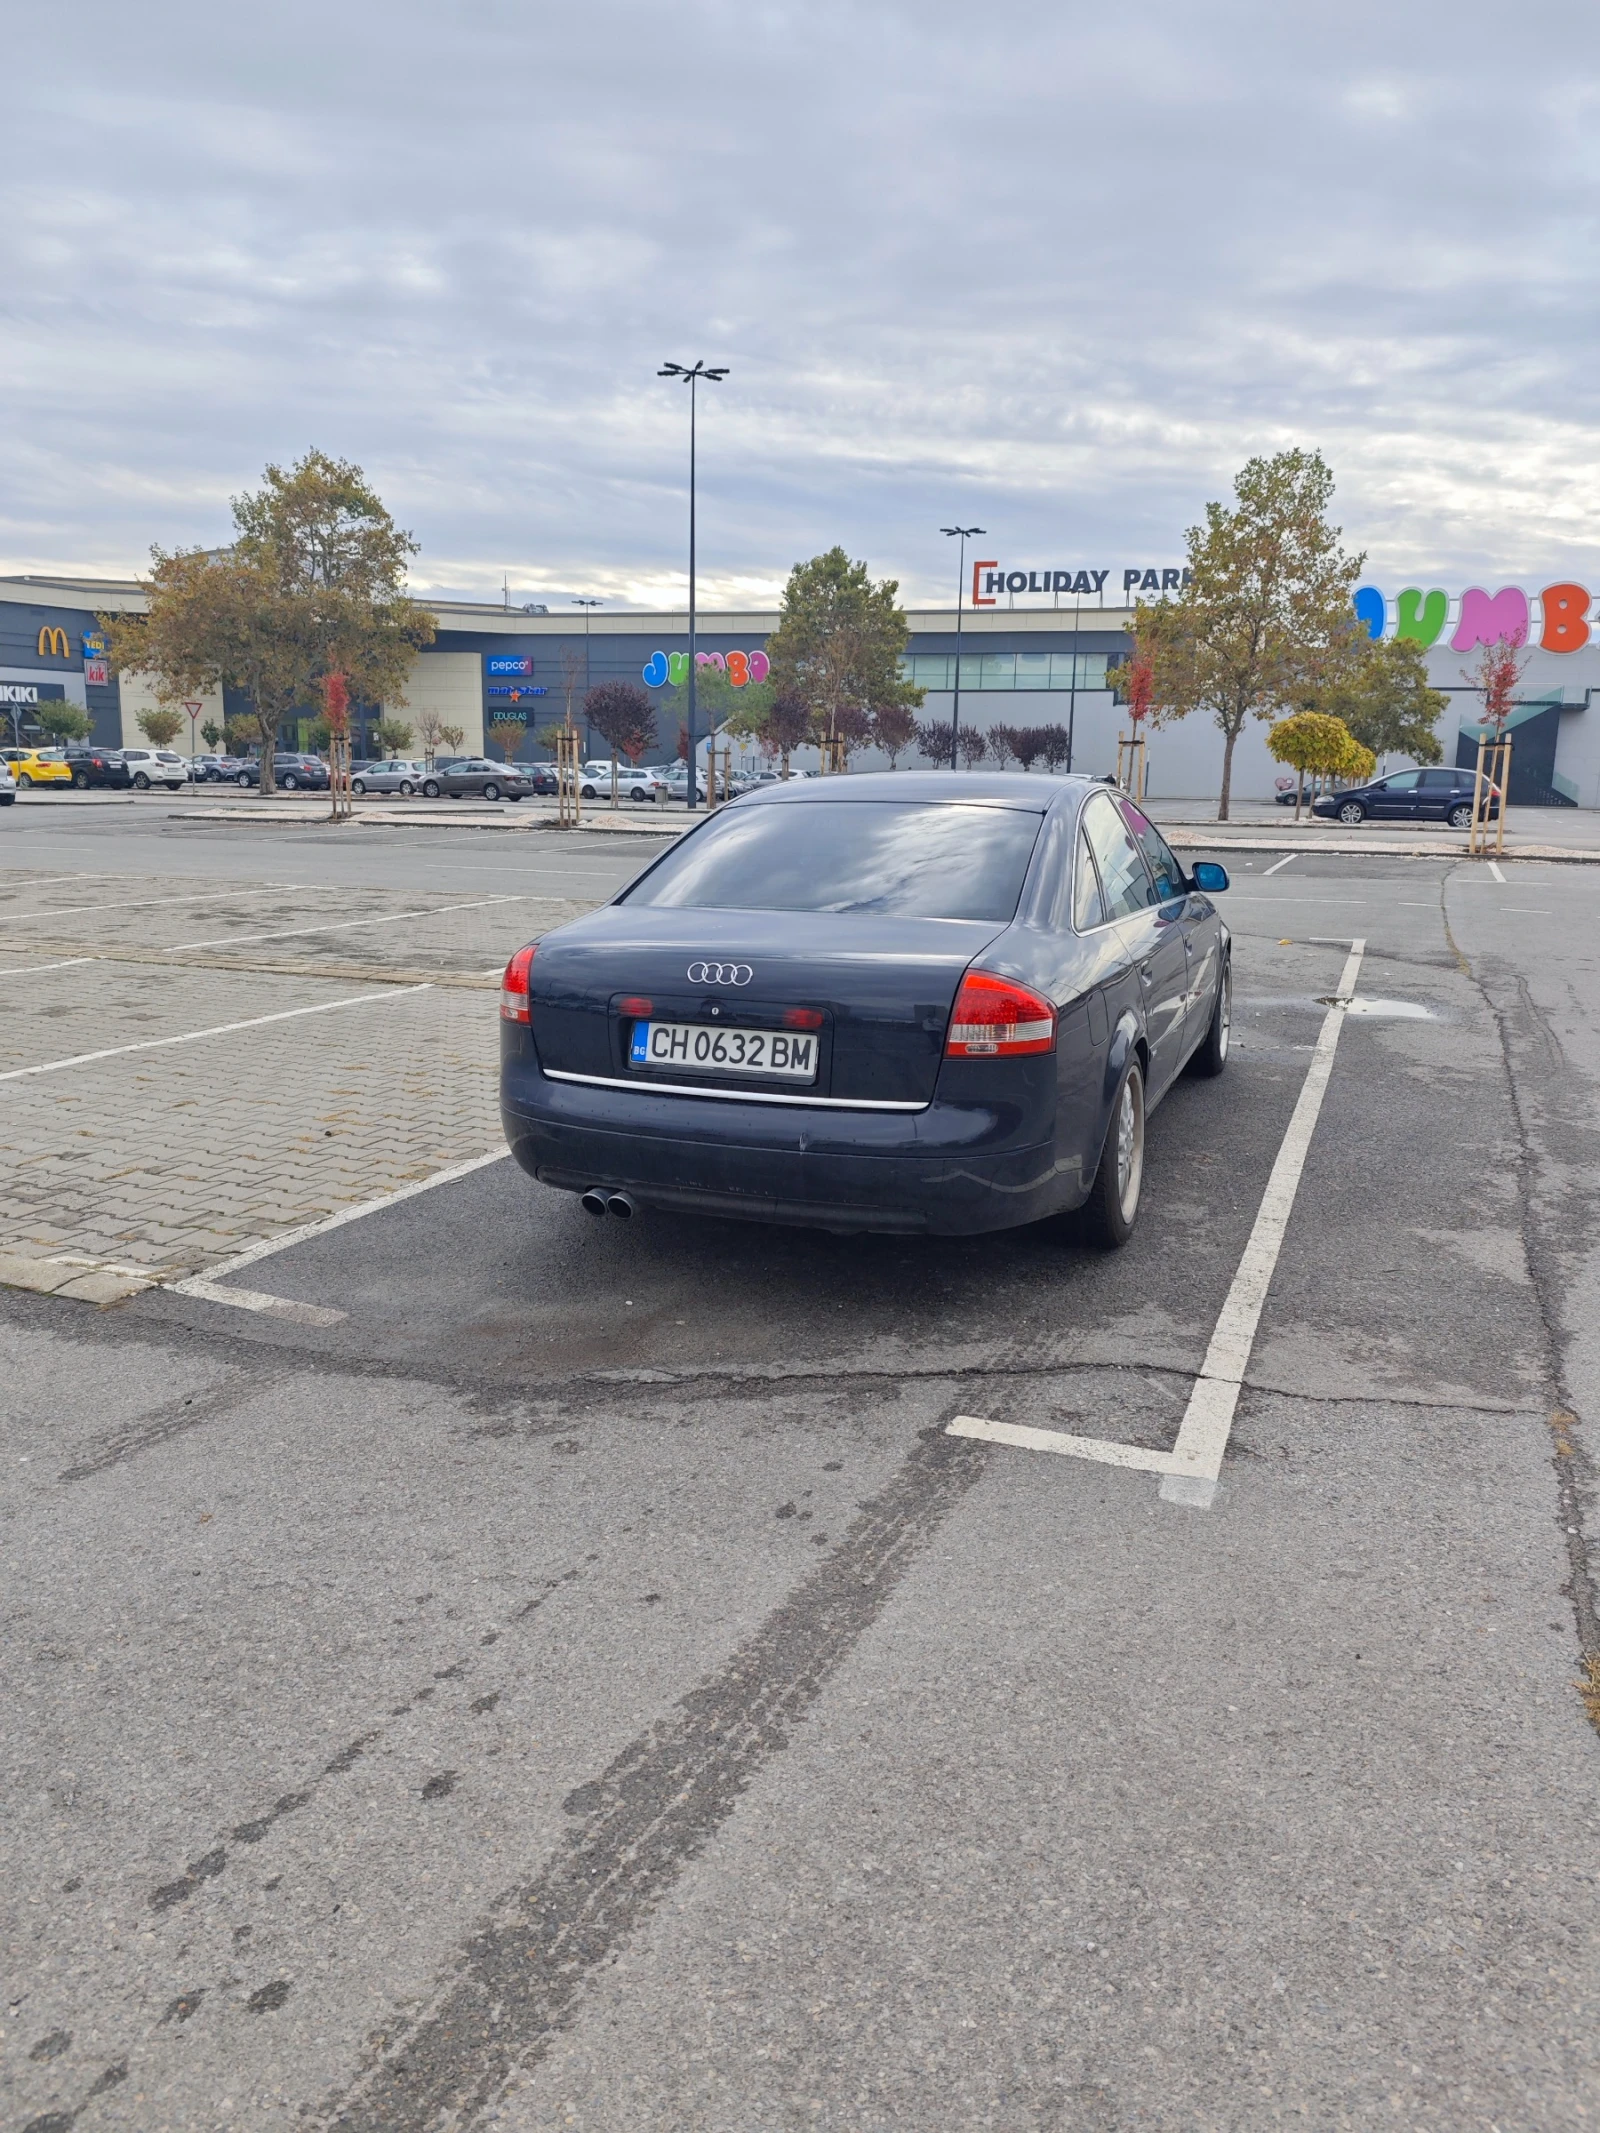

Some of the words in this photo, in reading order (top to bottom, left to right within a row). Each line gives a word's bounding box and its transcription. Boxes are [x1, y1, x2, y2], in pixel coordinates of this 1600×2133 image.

[986, 570, 1110, 593] HOLIDAY
[491, 661, 526, 671] pepco
[493, 711, 527, 720] DOUGLAS
[633, 1045, 646, 1056] BG
[652, 1027, 689, 1060] CH
[694, 1031, 766, 1067] 0632
[770, 1037, 812, 1071] BM
